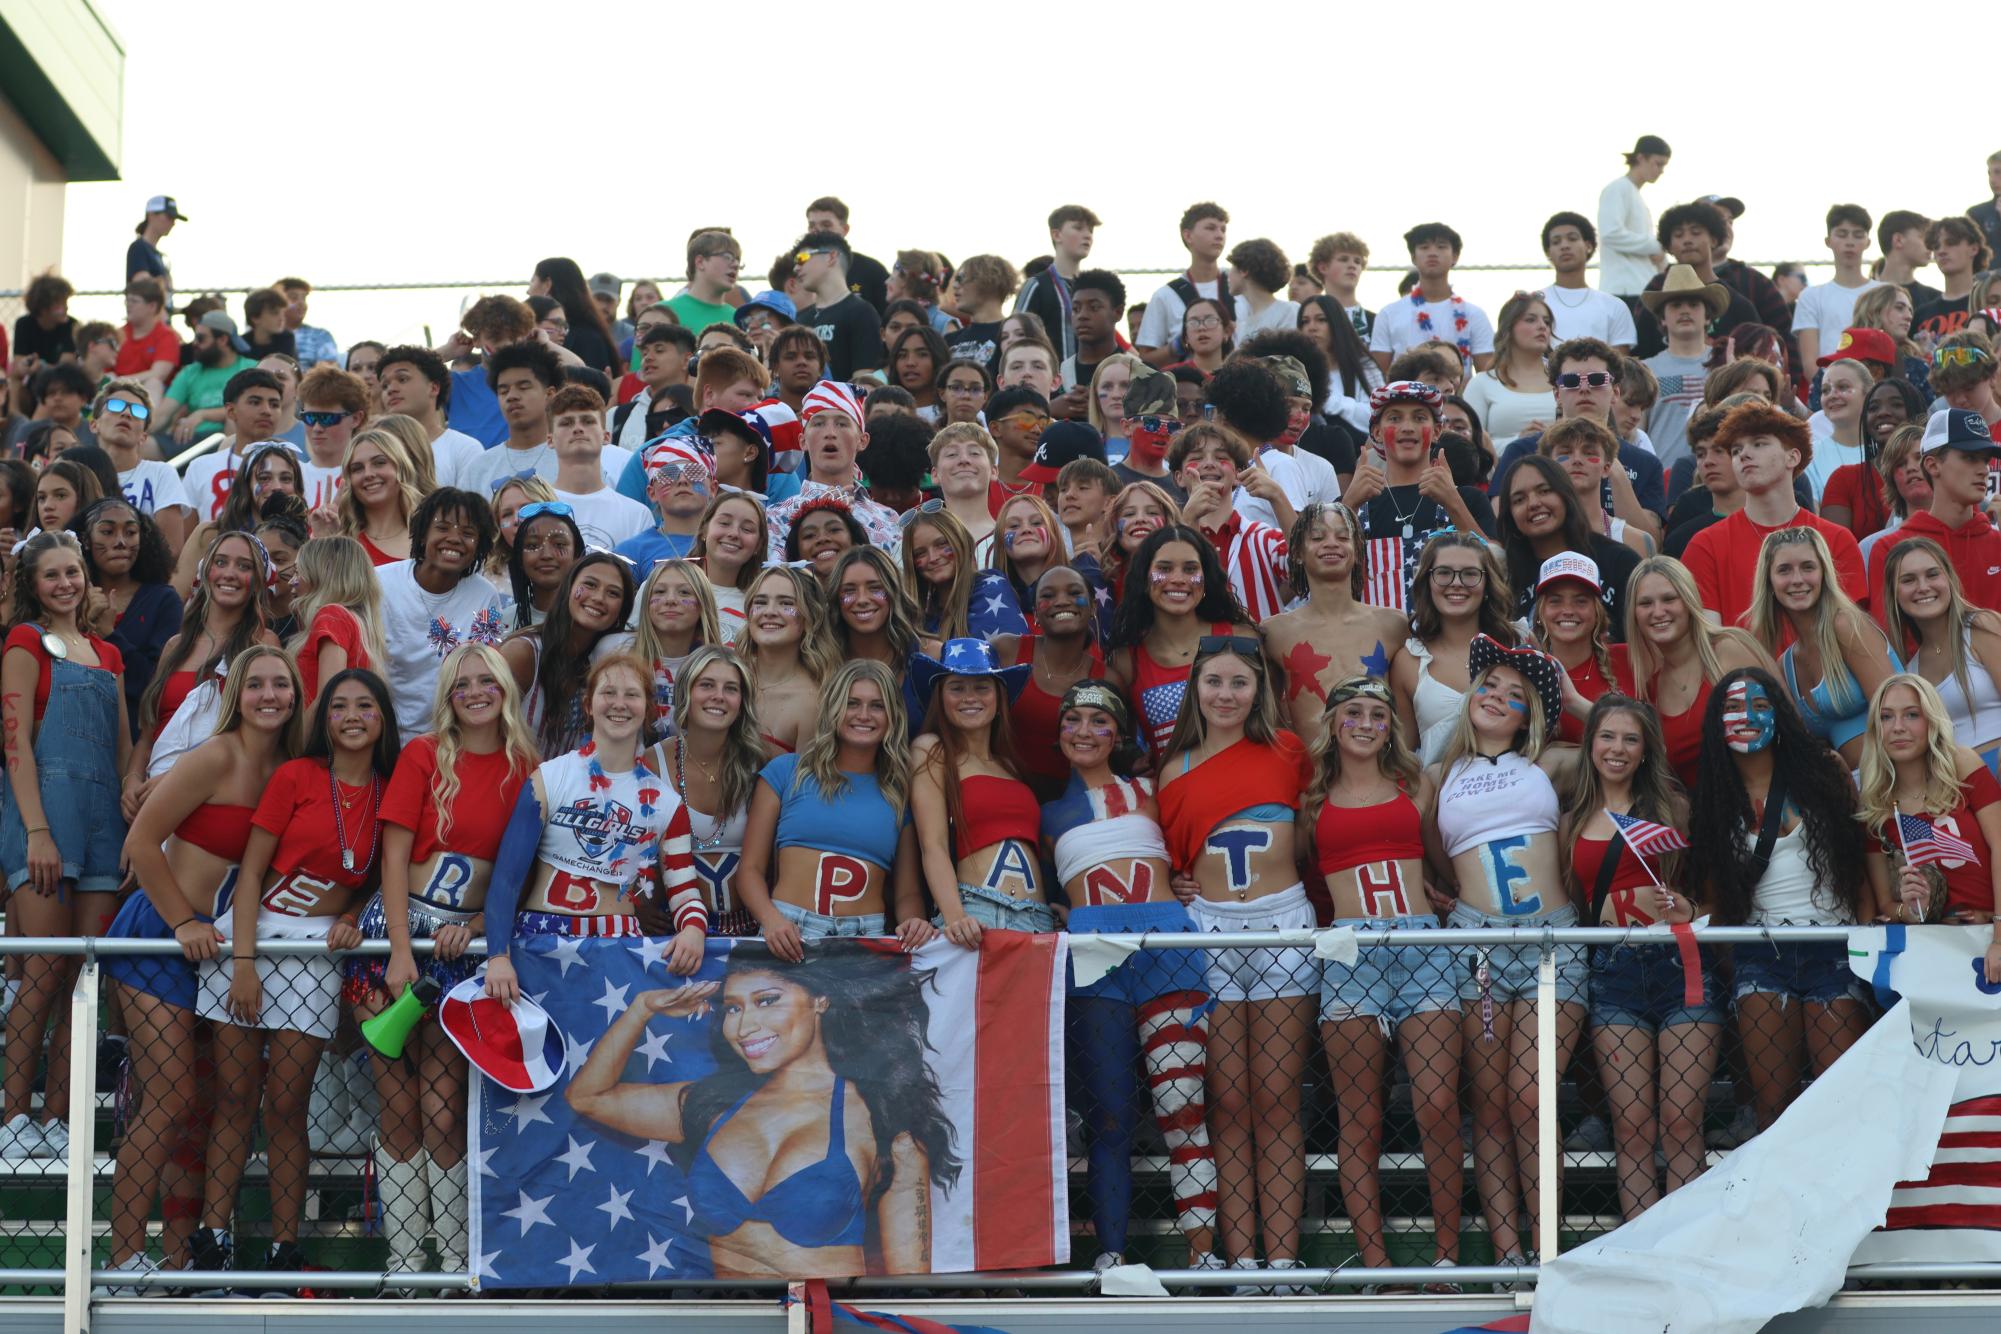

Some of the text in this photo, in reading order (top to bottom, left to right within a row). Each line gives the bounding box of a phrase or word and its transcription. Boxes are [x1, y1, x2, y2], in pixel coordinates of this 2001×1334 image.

[1460, 768, 1518, 785] TAKE ME
[1462, 778, 1506, 791] HOME
[550, 812, 584, 827] ALL
[585, 817, 646, 840] GIRLS
[693, 851, 742, 912] Y
[815, 824, 1658, 927] P A N T H E R
